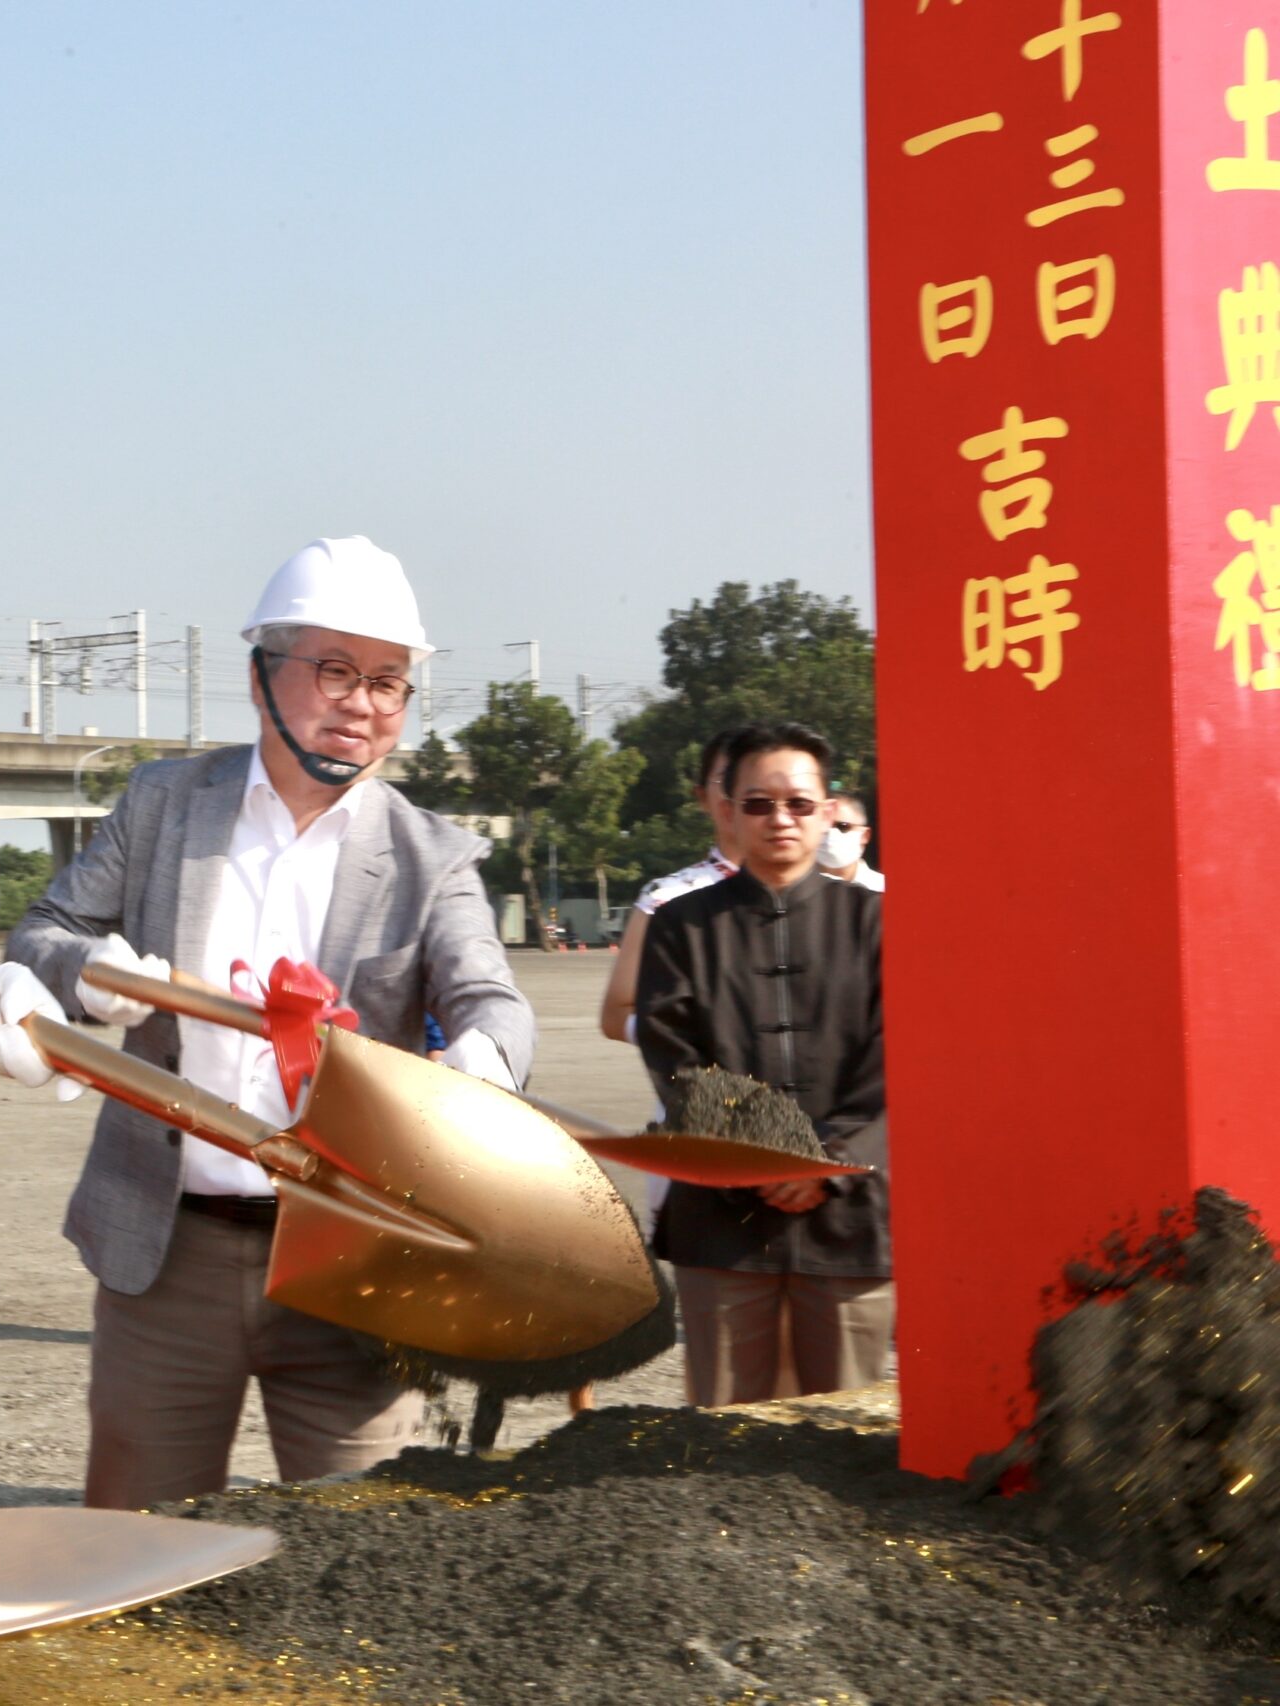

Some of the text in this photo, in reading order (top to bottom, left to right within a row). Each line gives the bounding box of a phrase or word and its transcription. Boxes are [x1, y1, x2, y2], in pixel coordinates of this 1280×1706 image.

[902, 0, 1004, 363] 一日
[1021, 0, 1125, 345] 十三日
[958, 406, 1081, 691] 吉時
